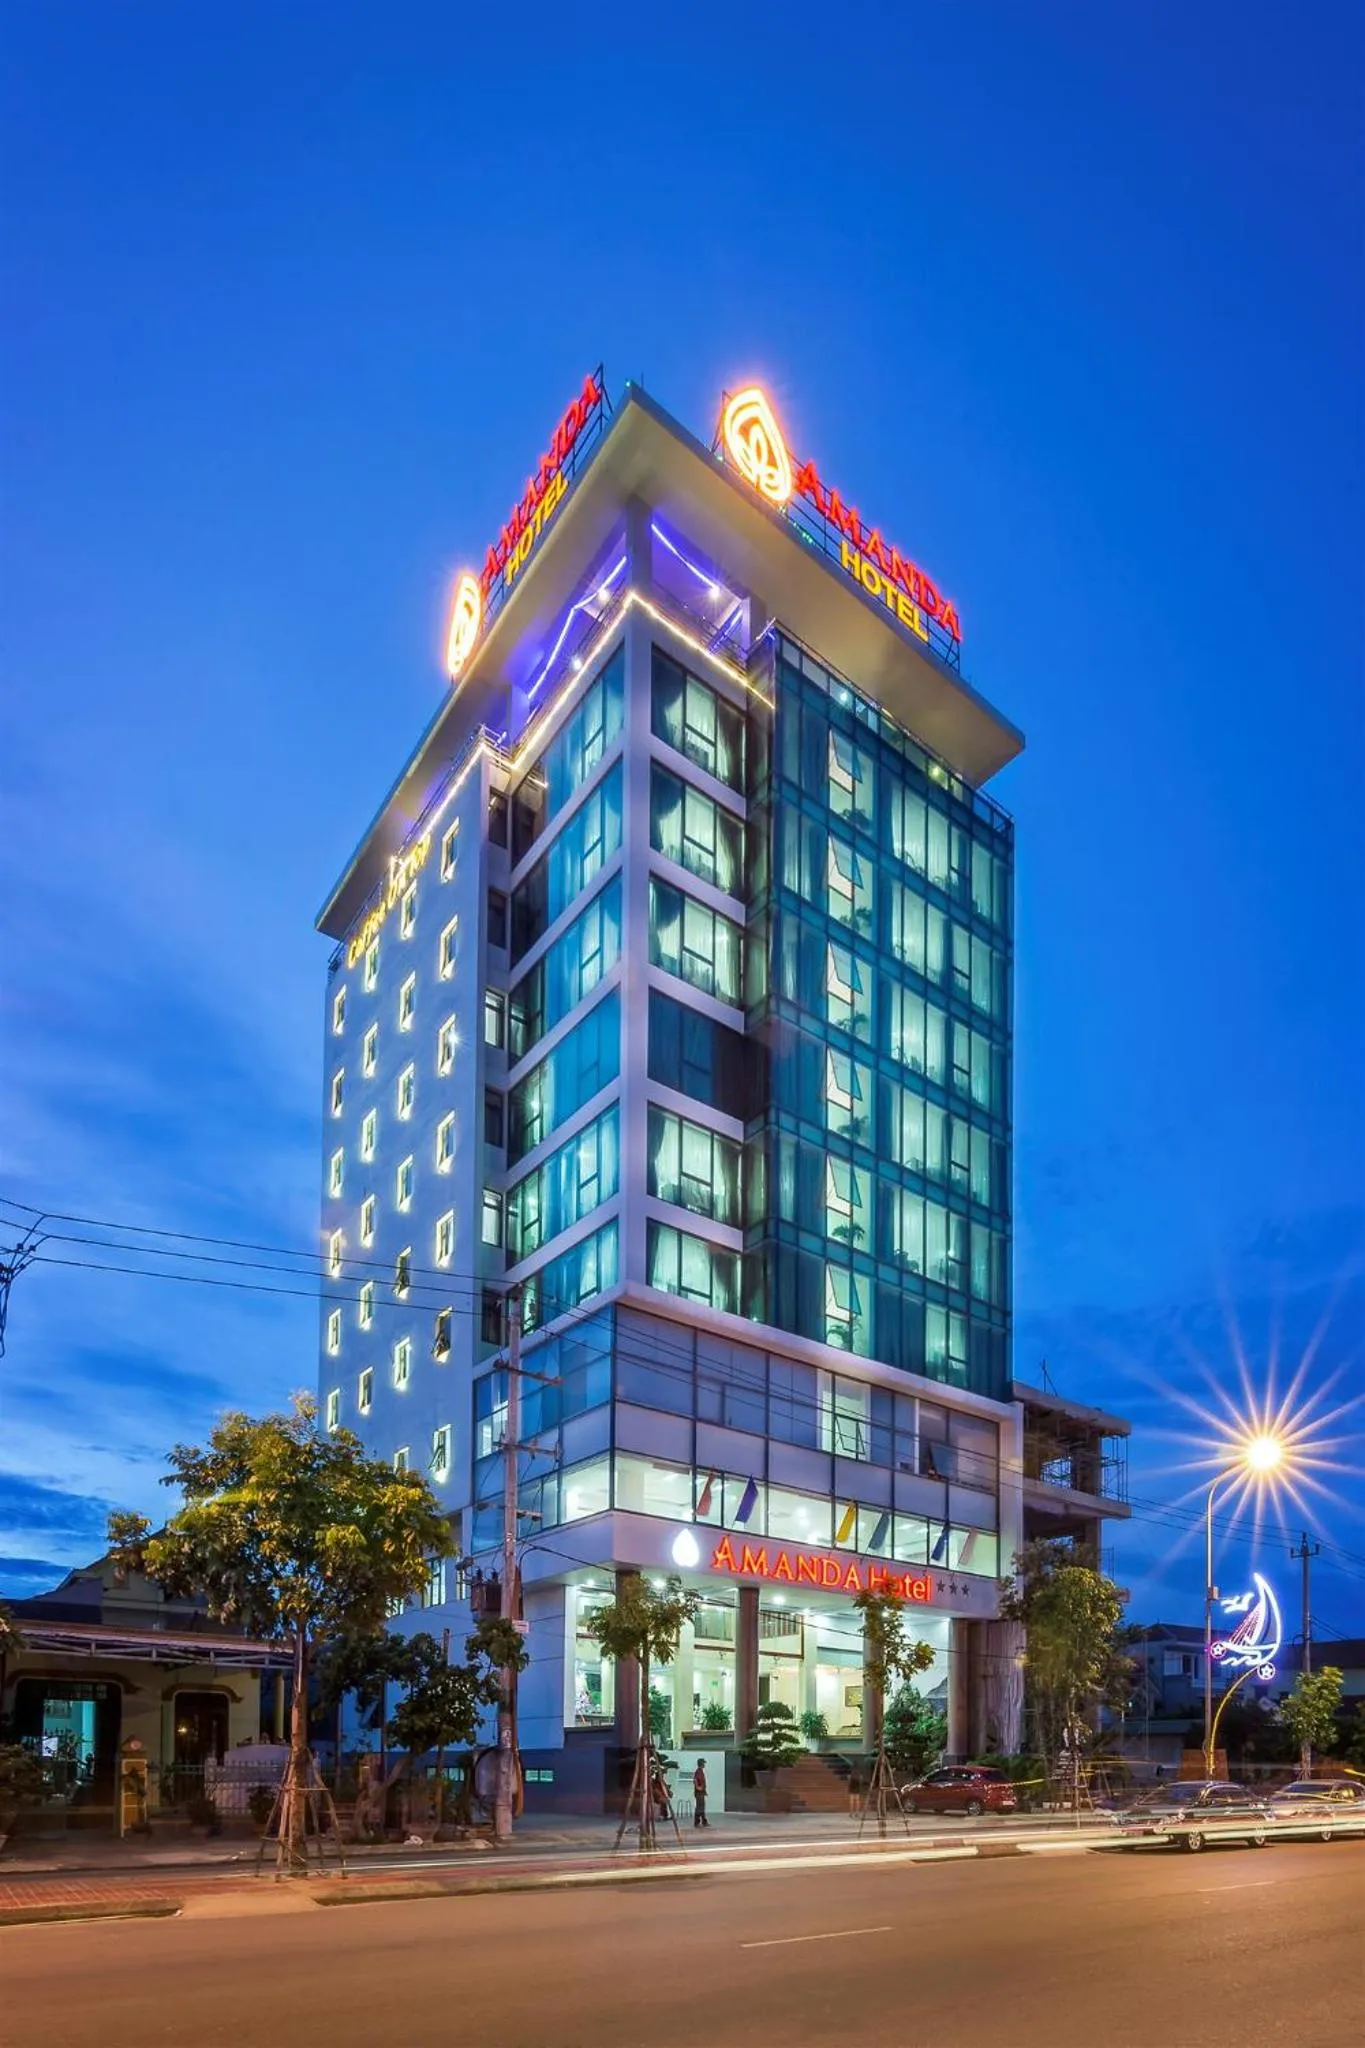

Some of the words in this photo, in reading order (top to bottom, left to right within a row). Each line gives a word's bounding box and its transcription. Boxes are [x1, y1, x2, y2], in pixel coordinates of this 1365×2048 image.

[481, 375, 601, 600] AMANDA
[505, 471, 569, 586] HOTEL
[796, 460, 962, 641] AMANDA
[840, 541, 930, 643] HOTEL
[713, 1536, 861, 1590] AMANDA
[868, 1566, 932, 1602] Hotel
